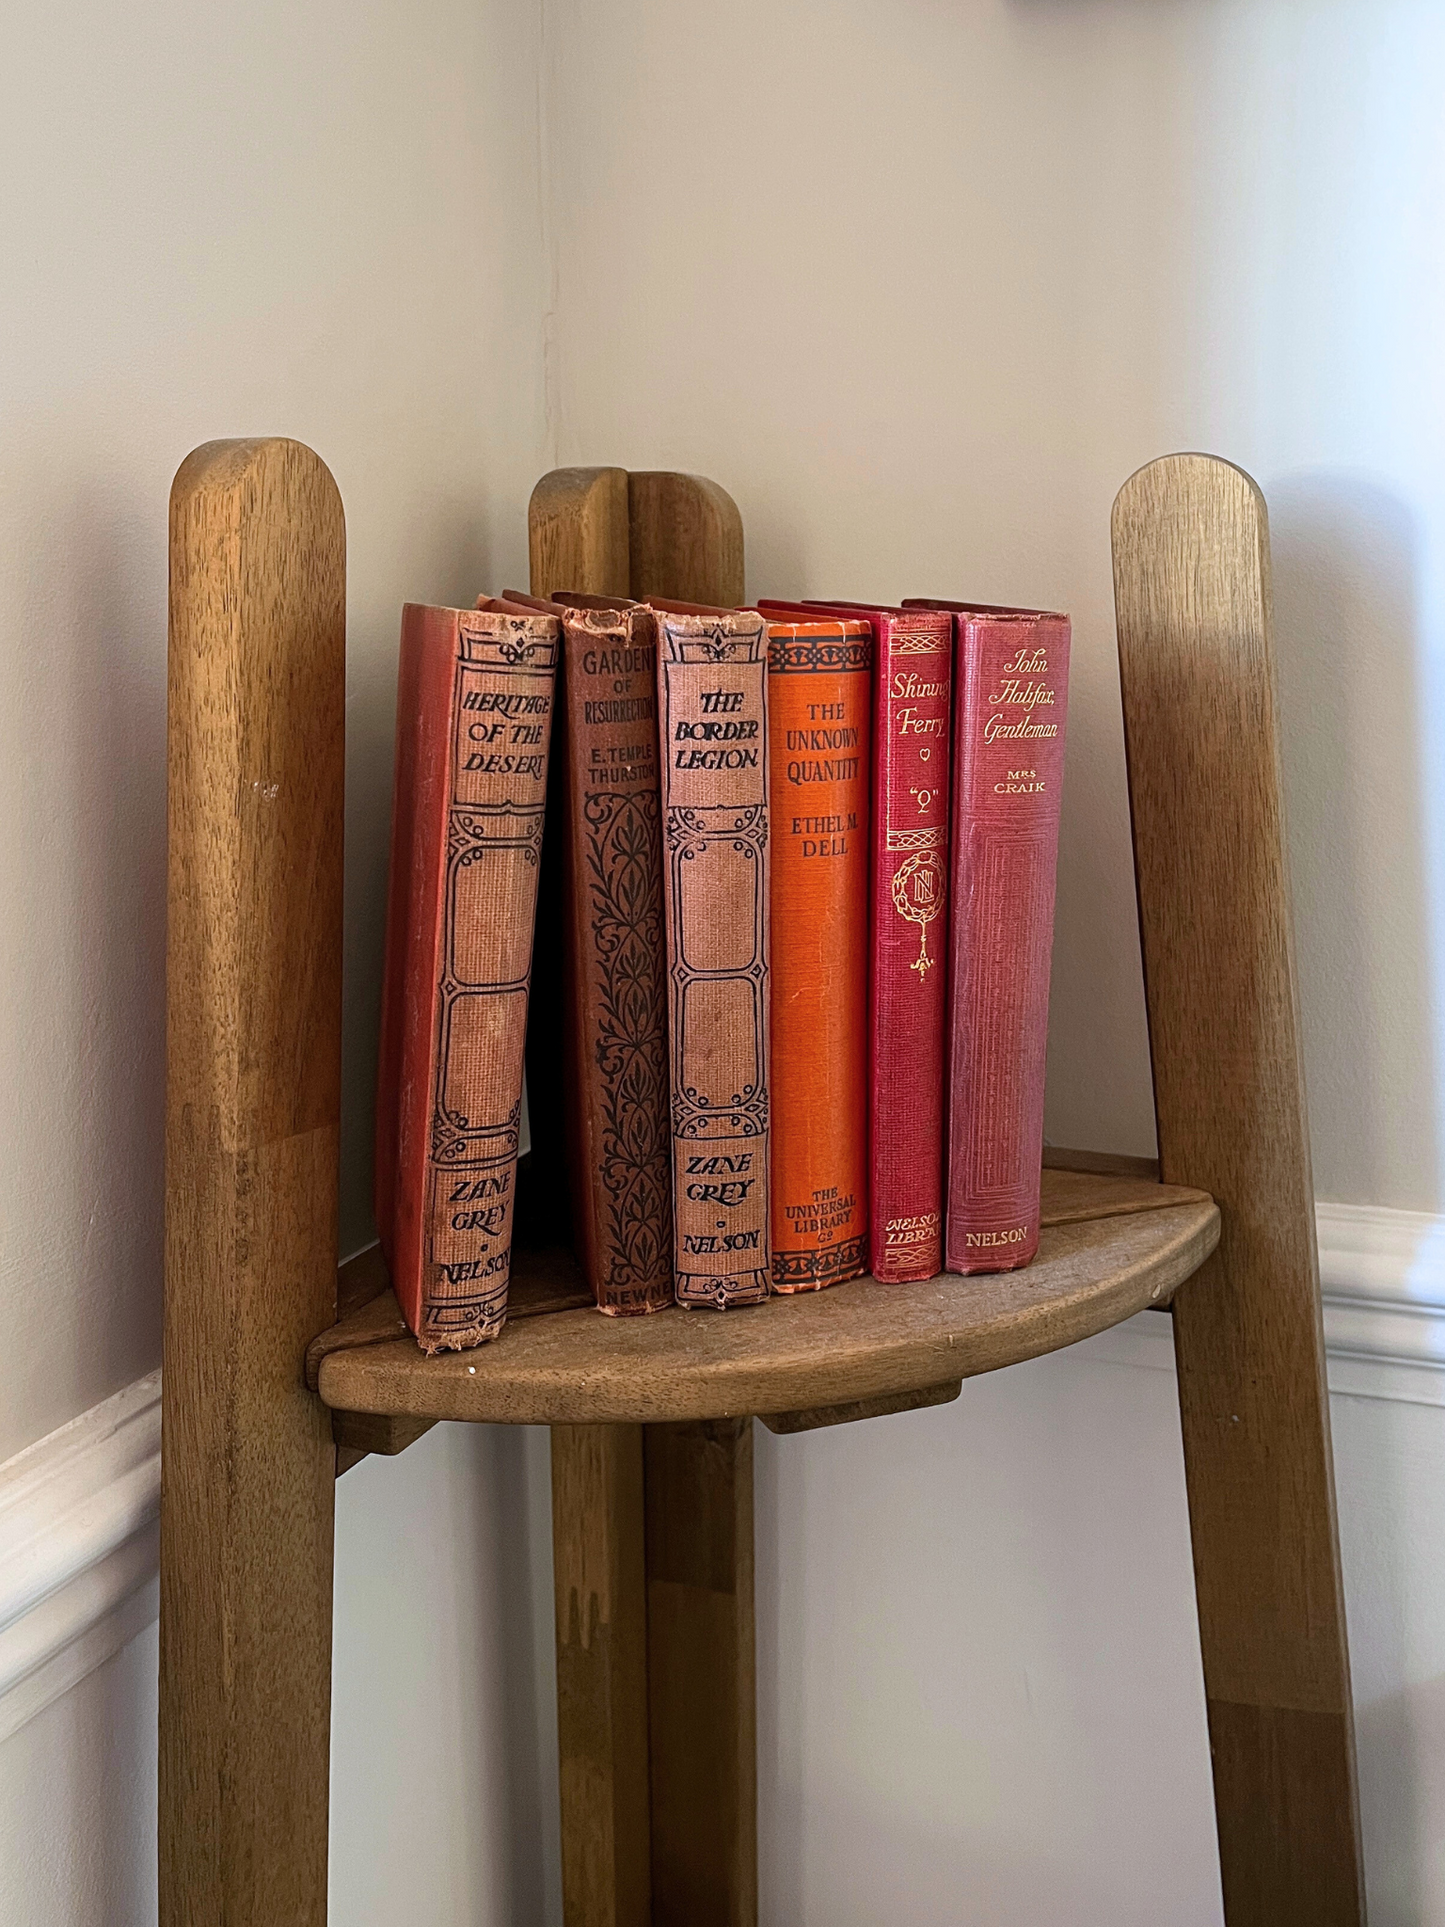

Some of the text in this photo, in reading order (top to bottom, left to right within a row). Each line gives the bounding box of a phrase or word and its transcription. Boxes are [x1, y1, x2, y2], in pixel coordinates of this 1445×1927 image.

[582, 647, 651, 675] GARDEN
[1003, 648, 1048, 673] John
[613, 679, 632, 694] OF
[890, 672, 949, 702] Shining
[988, 680, 1055, 712] Halifax,
[462, 691, 550, 720] HERITAGE
[700, 688, 744, 714] THE
[807, 702, 845, 721] THE
[468, 722, 544, 745] OF THE
[675, 720, 759, 741] BORDER
[895, 706, 946, 739] Ferry
[984, 713, 1058, 745] Gentleman
[786, 727, 860, 751] UNKNOWN
[591, 743, 652, 764] E. TEMPLE
[675, 748, 759, 770] LEGION
[462, 752, 545, 781] DESERT
[587, 762, 655, 784] THURSTON
[787, 756, 860, 786] QUANTITY
[993, 782, 1046, 794] CRAIK
[792, 815, 845, 835] ETHEL
[802, 837, 849, 858] DELL
[685, 1153, 754, 1176] ZANE
[449, 1170, 511, 1203] ZANE
[686, 1178, 755, 1208] GREY
[812, 1186, 838, 1203] THE
[451, 1200, 510, 1237] GREY
[785, 1193, 857, 1220] UNIVERSAL
[794, 1209, 853, 1234] LIBRARY
[683, 1229, 760, 1255] NELSON
[885, 1226, 938, 1245] LIBRA
[965, 1226, 1028, 1248] NELSON
[440, 1246, 511, 1284] NELSON
